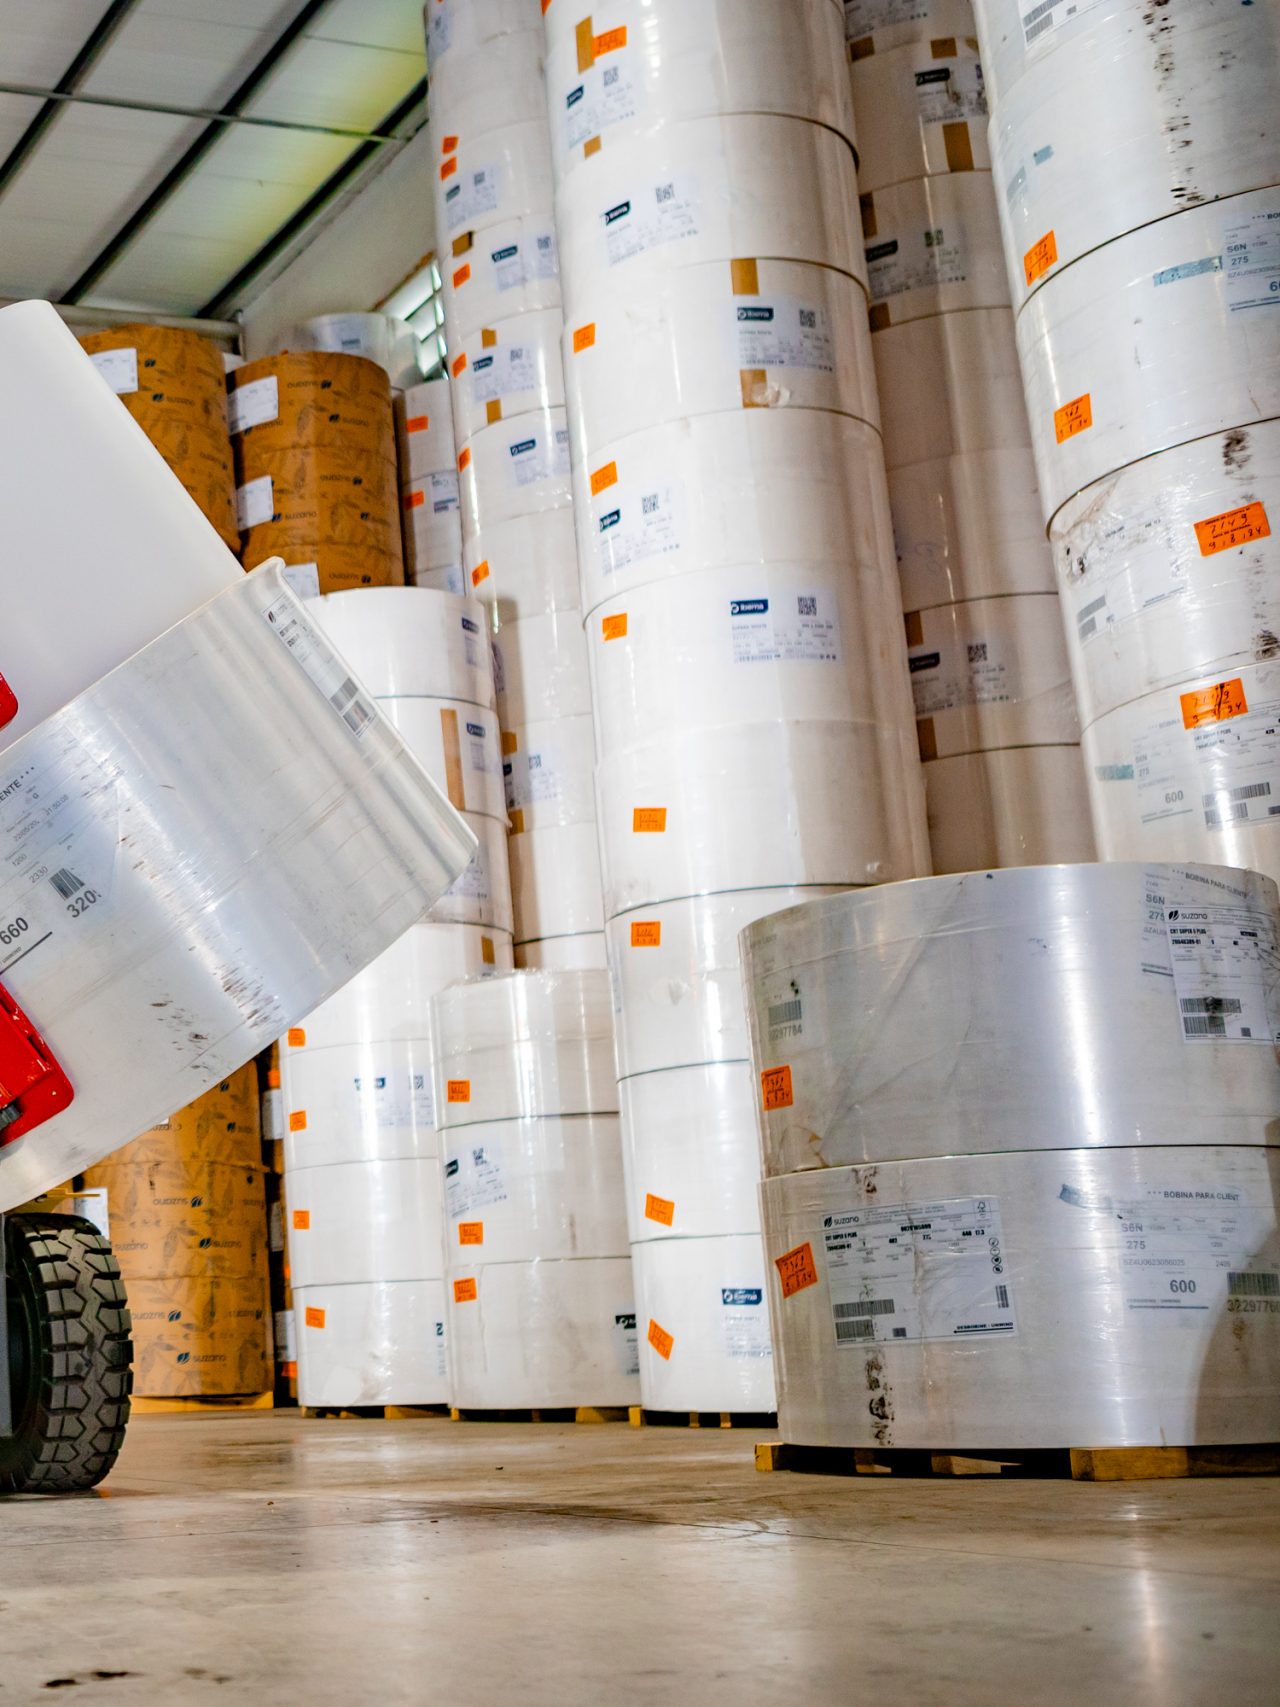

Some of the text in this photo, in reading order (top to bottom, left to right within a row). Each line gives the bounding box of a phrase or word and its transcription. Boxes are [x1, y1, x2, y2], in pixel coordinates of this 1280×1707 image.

[1226, 243, 1247, 253] S6N
[1231, 256, 1249, 266] 275
[285, 511, 317, 520] suzano
[1164, 790, 1184, 804] 600
[1185, 872, 1209, 885] BOBINA
[1210, 879, 1226, 890] PARA
[1145, 894, 1165, 905] S6N
[1180, 912, 1208, 920] suzano
[1163, 1191, 1194, 1199] BOBINA
[1195, 1191, 1216, 1200] PARA
[153, 1197, 189, 1206] suzano
[833, 1216, 860, 1226] suzano
[1121, 1223, 1143, 1232] S6N
[114, 1241, 148, 1250] suzano
[213, 1239, 242, 1248] suzano
[1126, 1240, 1146, 1250] 275
[1169, 1279, 1197, 1294] 600
[131, 1310, 165, 1320] suzano
[193, 1353, 227, 1363] suzano
